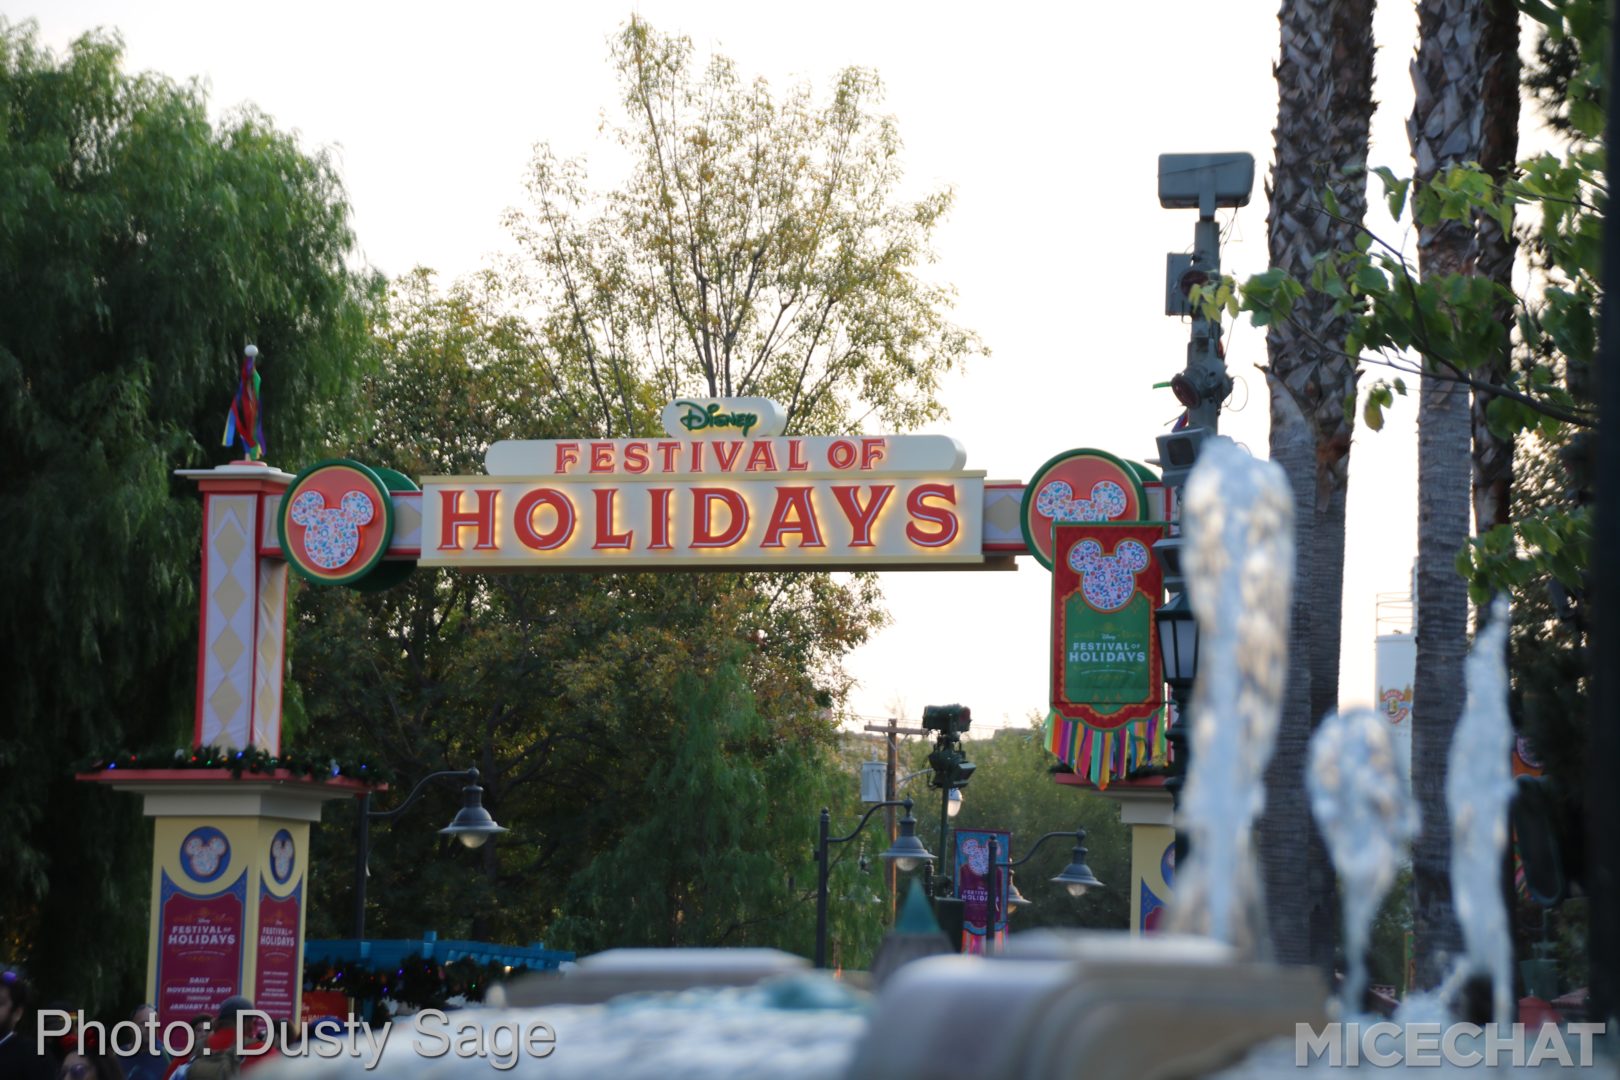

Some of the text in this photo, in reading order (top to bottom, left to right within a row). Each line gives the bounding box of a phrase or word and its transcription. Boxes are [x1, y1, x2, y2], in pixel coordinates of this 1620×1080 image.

[675, 401, 758, 437] Disney
[554, 437, 886, 475] FESTIVAL OF
[437, 484, 960, 551] HOLIDAYS
[1073, 642, 1130, 650] FESTIVAL
[1069, 652, 1146, 662] HOLIDAYS
[172, 925, 222, 934] FESTIVAL
[262, 927, 288, 936] FESTIVAL
[168, 934, 236, 945] HOLIDAYS
[260, 936, 295, 947] HOLIDAYS
